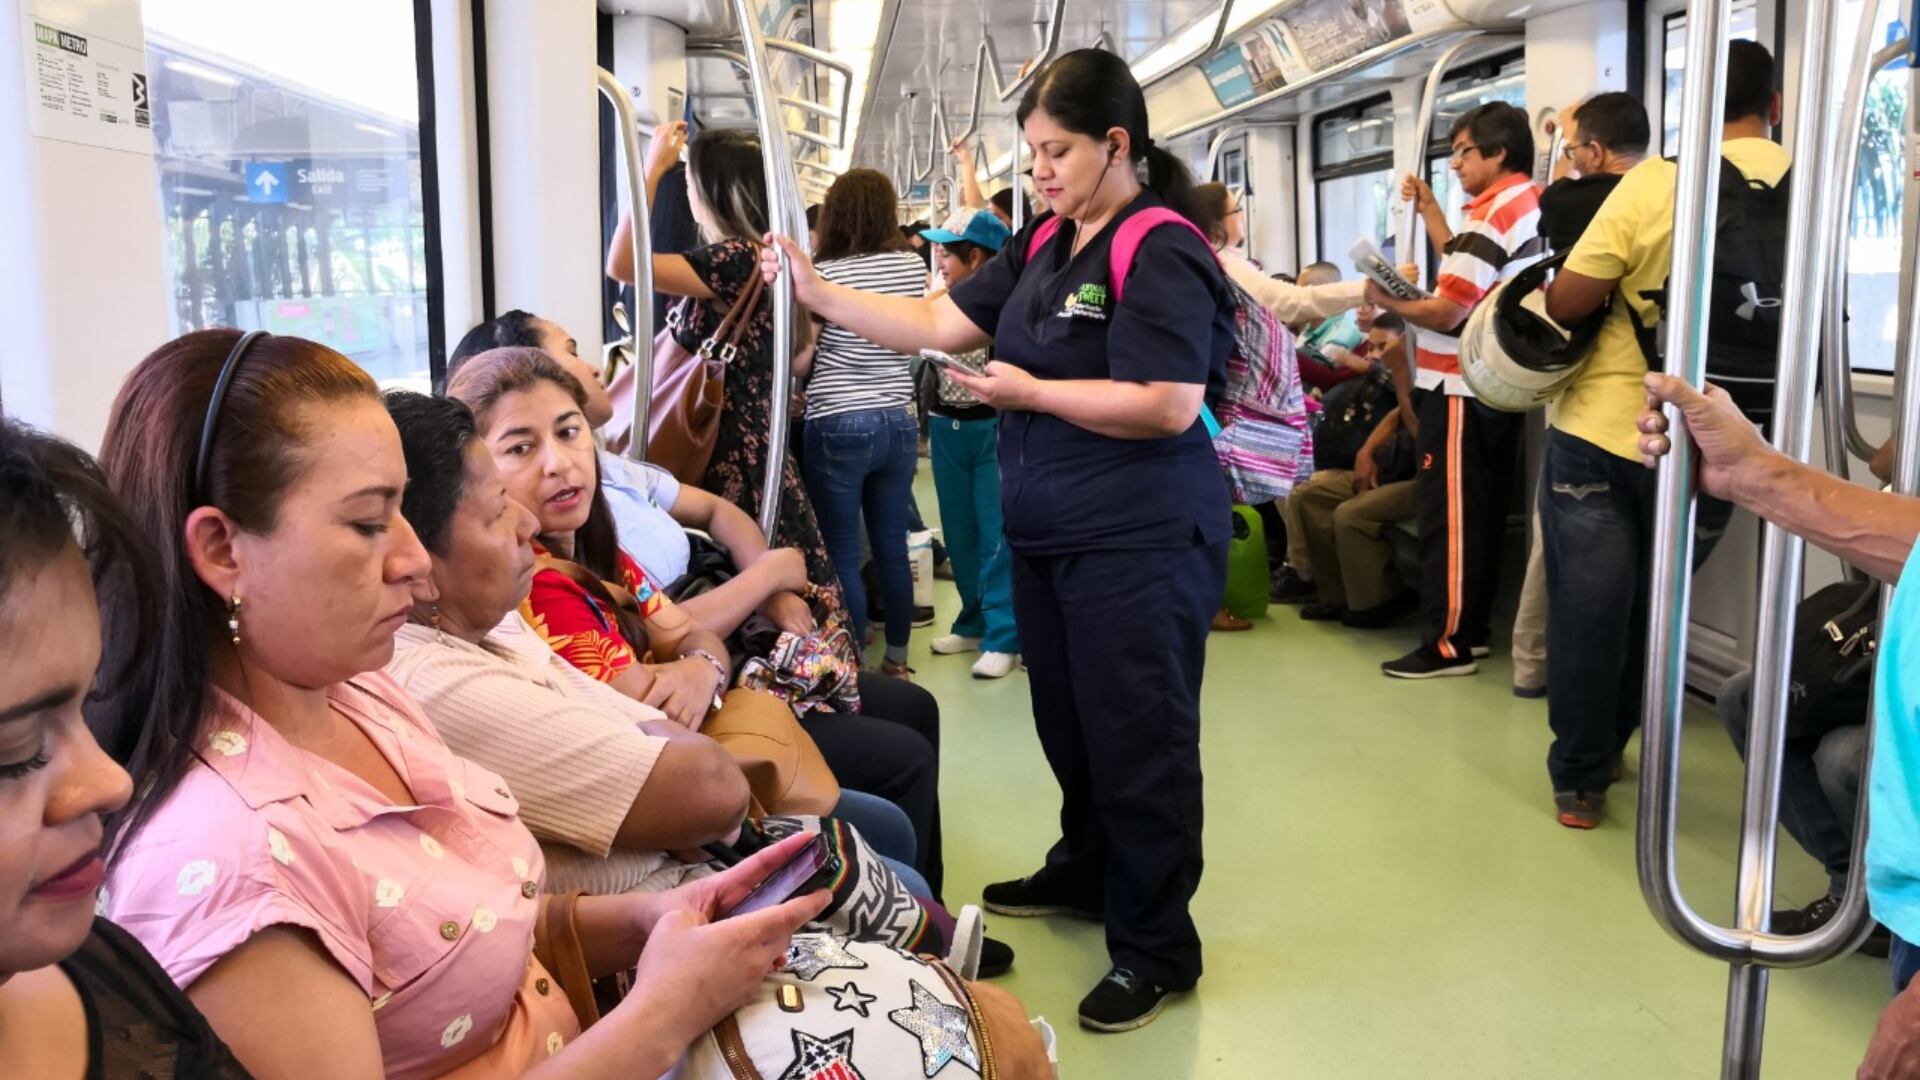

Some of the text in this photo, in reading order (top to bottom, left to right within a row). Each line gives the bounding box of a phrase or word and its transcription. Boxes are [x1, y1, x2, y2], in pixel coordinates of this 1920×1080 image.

[36, 25, 87, 54] MAPA METRO
[297, 169, 345, 183] Salida
[311, 184, 333, 195] Exit
[1078, 292, 1106, 305] SWEET
